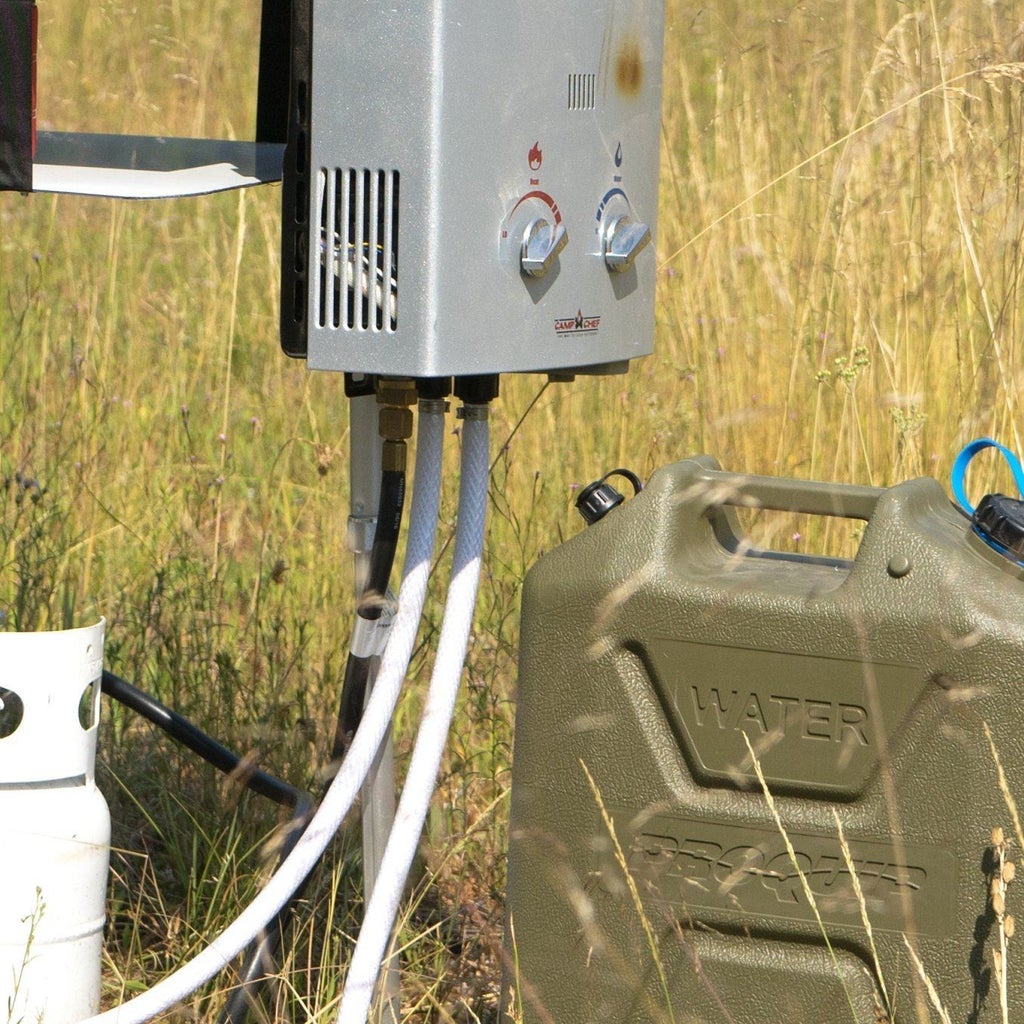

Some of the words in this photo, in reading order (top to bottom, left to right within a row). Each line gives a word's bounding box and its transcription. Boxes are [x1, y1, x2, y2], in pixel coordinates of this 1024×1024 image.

[554, 321, 574, 330] CAMP
[583, 319, 600, 328] CHEF
[690, 685, 870, 746] WATER
